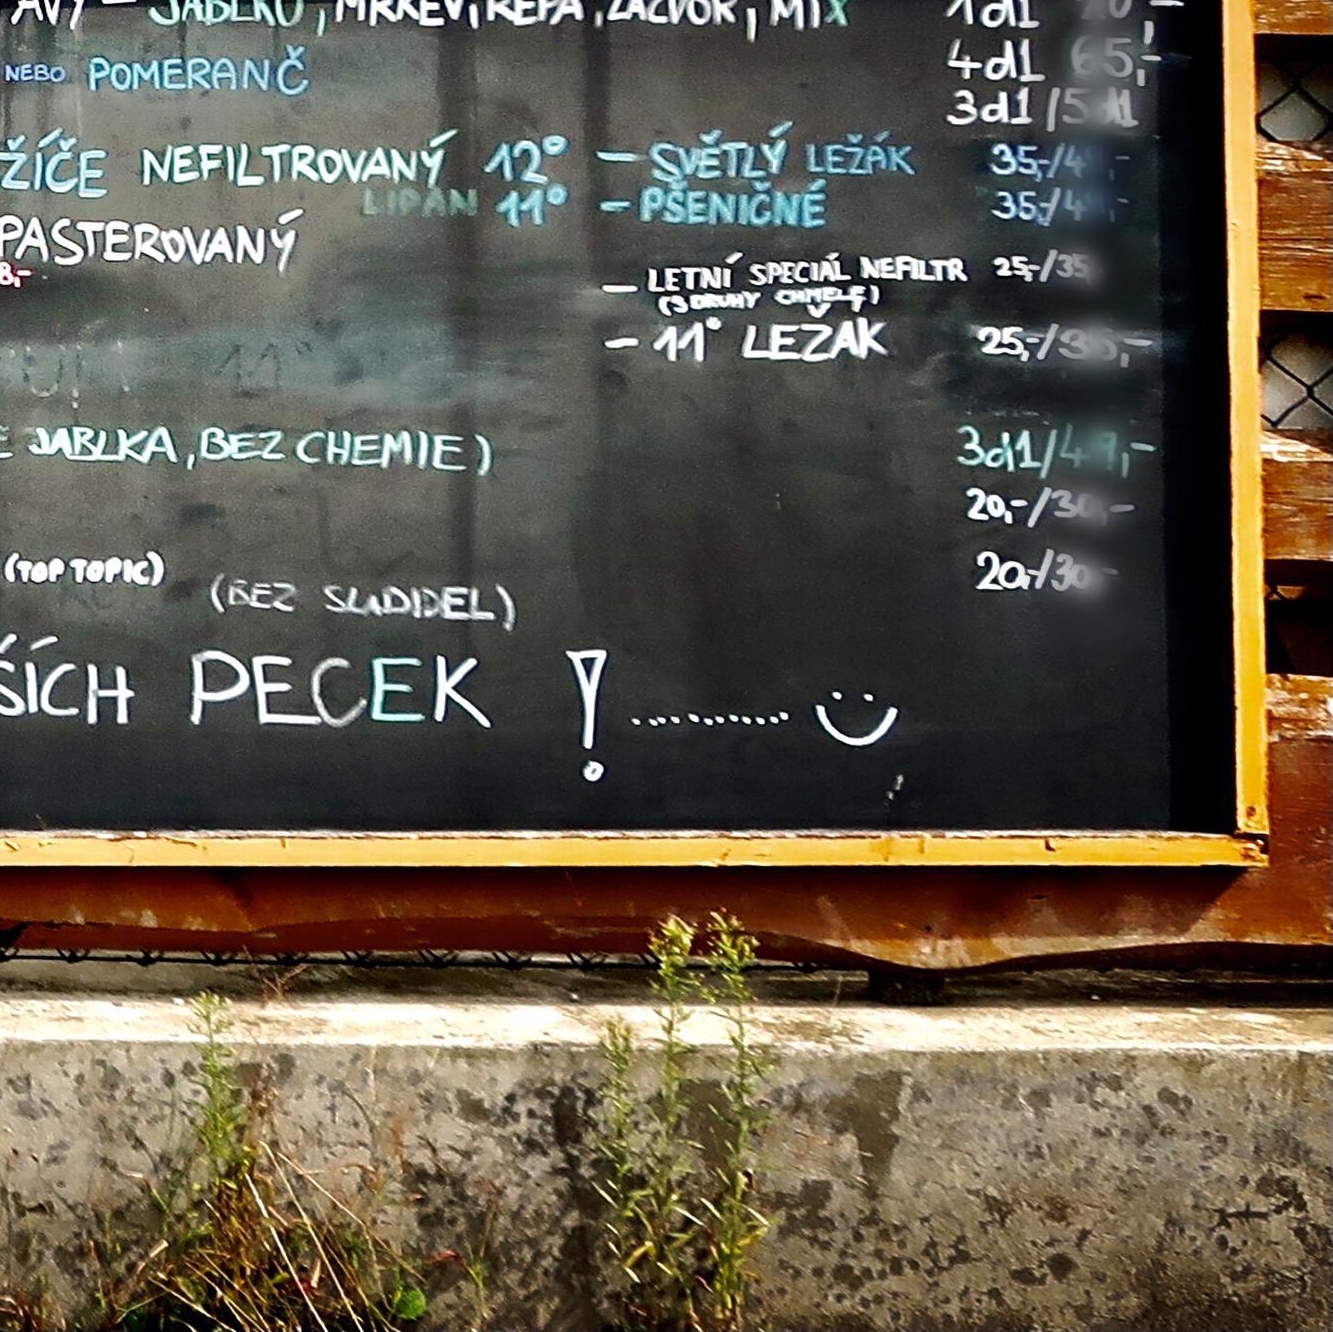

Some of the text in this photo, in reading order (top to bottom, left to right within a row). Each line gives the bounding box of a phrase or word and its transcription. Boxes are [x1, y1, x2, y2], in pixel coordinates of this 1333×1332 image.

[89, 44, 312, 97] POMERANČ
[140, 128, 459, 188] NEFILTROVANÝ
[648, 120, 796, 183] SVĚTLÝ
[805, 130, 916, 176] LEŽÁK
[639, 177, 830, 229] PŠENIČNÉ
[647, 251, 968, 293] LETNÍ SPECIÁL NEFILTR
[199, 427, 287, 462] BEZ
[190, 648, 493, 729] PECEK
